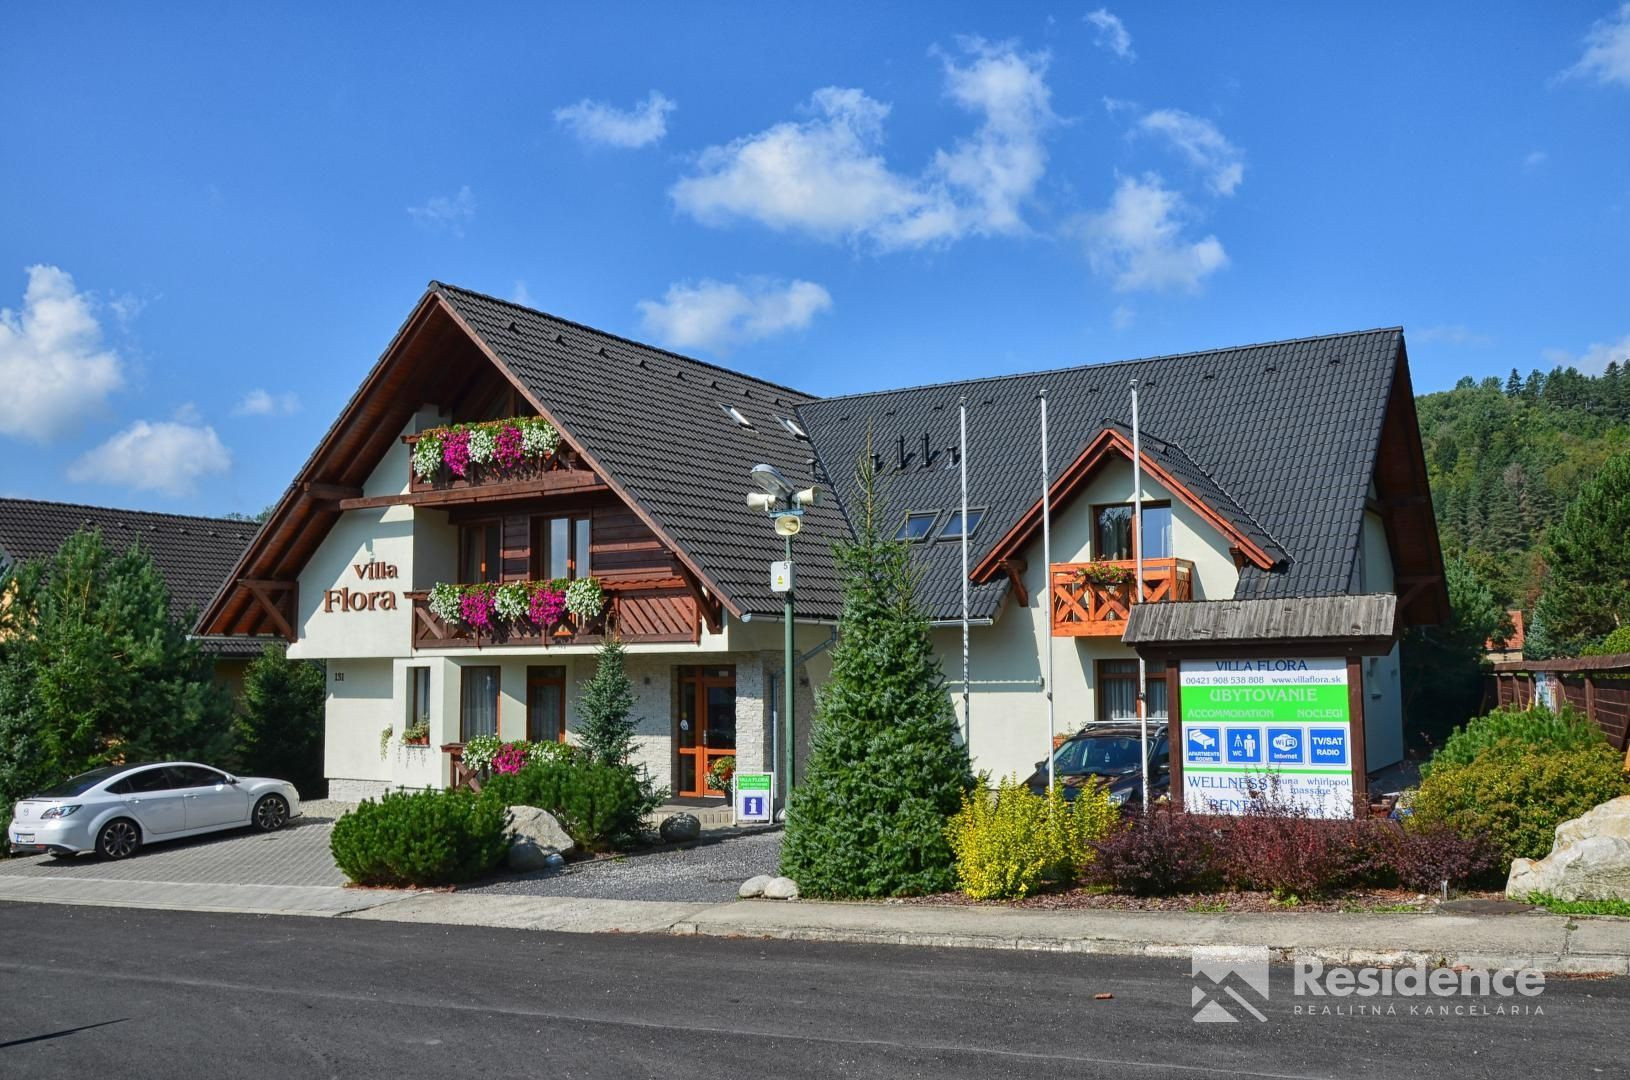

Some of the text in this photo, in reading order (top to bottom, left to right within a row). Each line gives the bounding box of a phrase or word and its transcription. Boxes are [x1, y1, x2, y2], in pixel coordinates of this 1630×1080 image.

[324, 587, 397, 612] Flora
[1216, 660, 1308, 672] VILLA FLORA
[1272, 676, 1341, 684] www.villaflora.sk
[1209, 688, 1318, 702] UBYTOVANIE
[1188, 708, 1342, 718] ACCOMMODATION NOCLEGI
[1312, 737, 1343, 746] TV/SAT
[1188, 776, 1268, 790] WELLNESS
[1307, 778, 1349, 787] whirlpool
